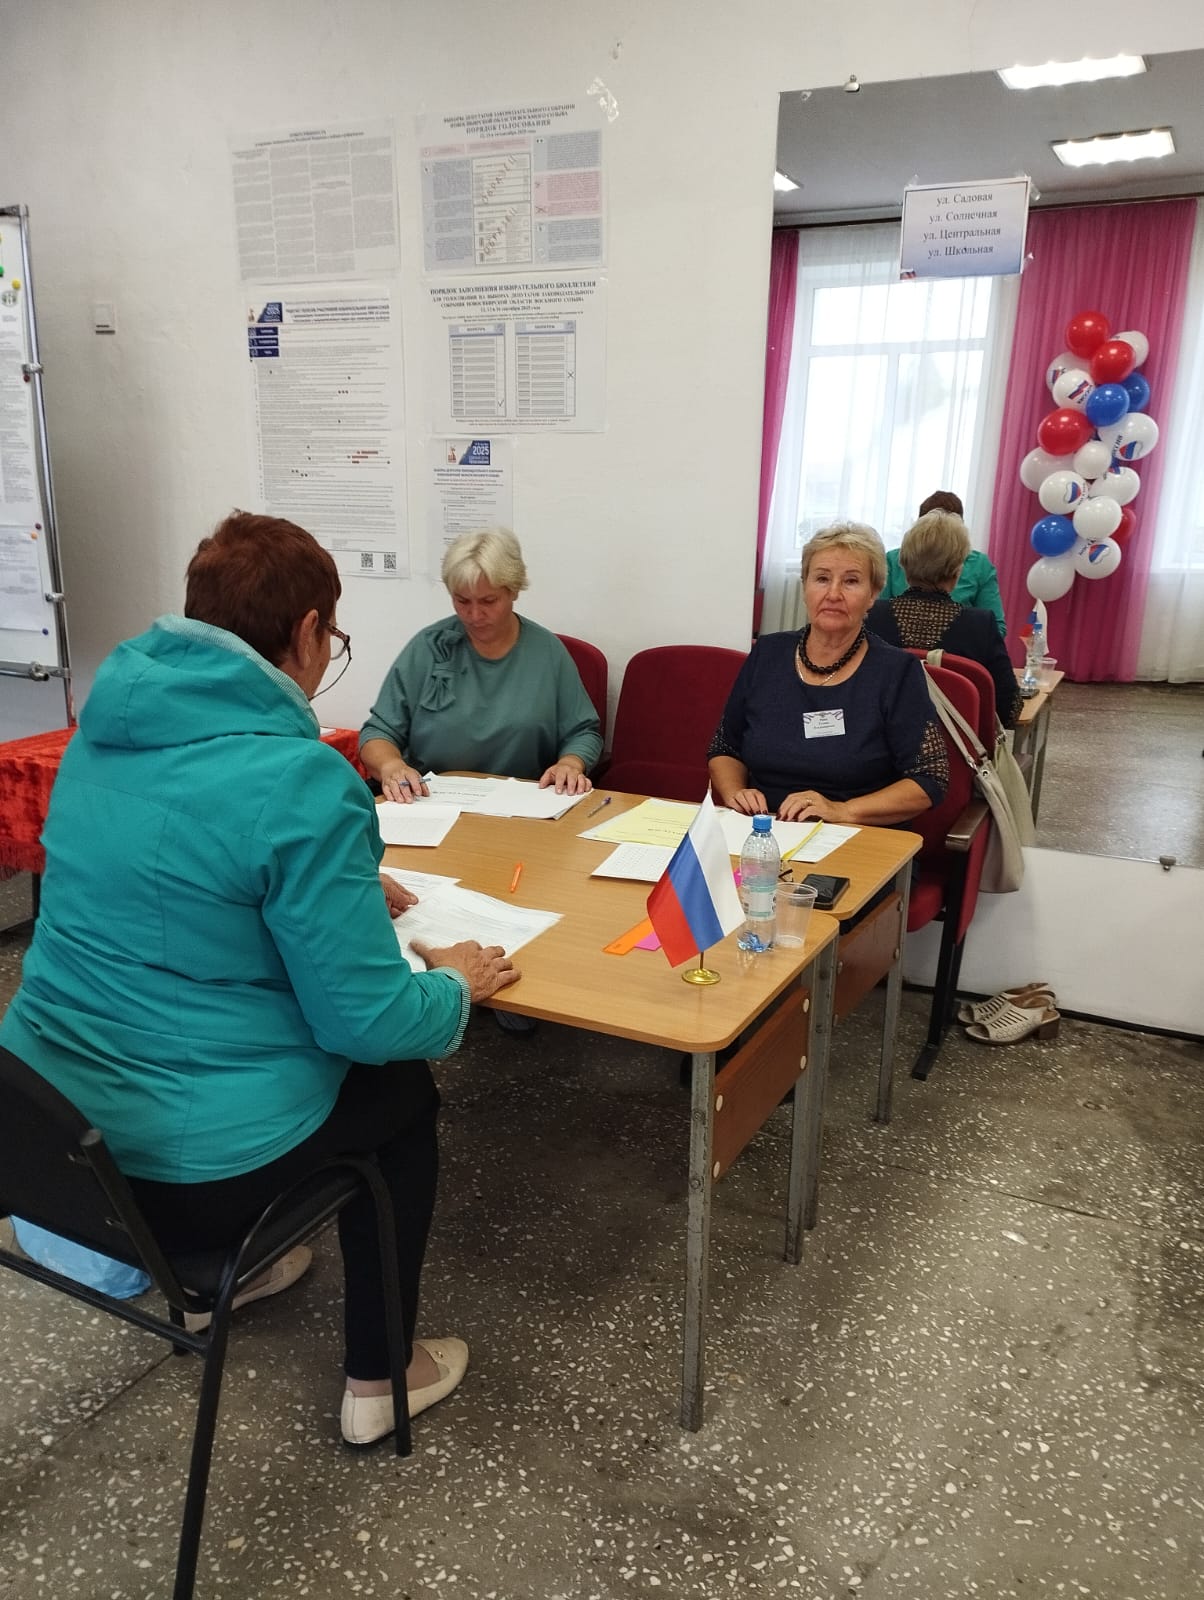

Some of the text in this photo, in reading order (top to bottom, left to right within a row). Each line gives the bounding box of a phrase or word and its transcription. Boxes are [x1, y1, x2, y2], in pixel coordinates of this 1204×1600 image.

[936, 193, 992, 206] ул. Садовая
[929, 210, 998, 224] ул. Солнечная
[923, 228, 1000, 242] ул. Центральная
[928, 246, 994, 260] ул. Школьная
[472, 446, 490, 456] 2025
